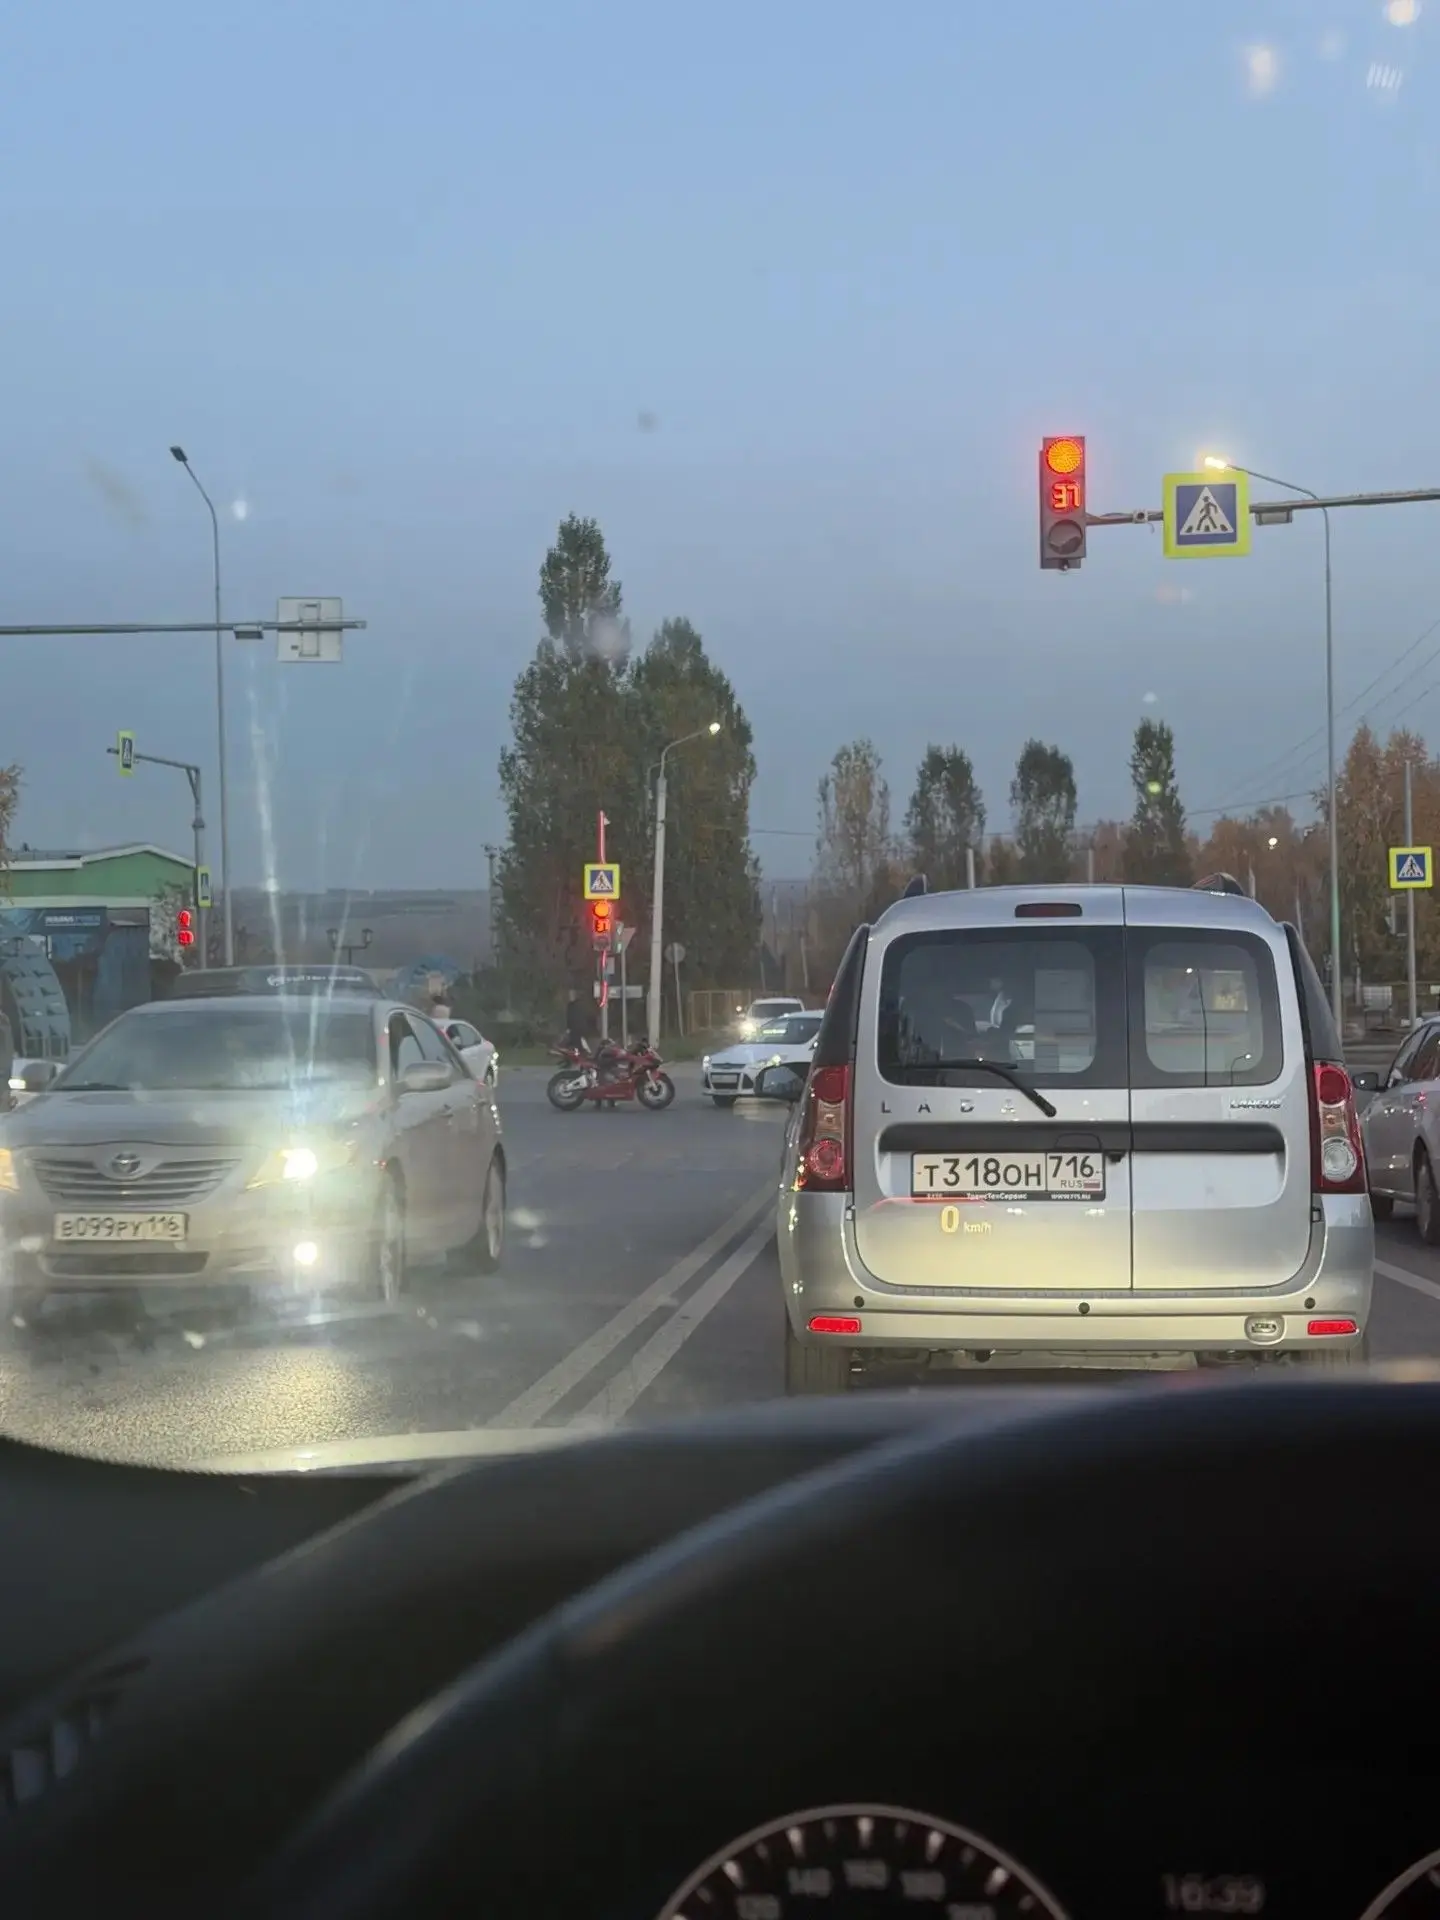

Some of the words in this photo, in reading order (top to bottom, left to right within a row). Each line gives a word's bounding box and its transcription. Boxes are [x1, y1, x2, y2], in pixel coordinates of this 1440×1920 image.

[1053, 484, 1080, 509] 37
[881, 1099, 1016, 1114] LADA
[923, 1157, 1042, 1187] Т318ОН
[1049, 1155, 1094, 1178] 716
[1060, 1180, 1083, 1188] RUS
[941, 1205, 960, 1234] 0
[963, 1220, 992, 1236] km/h
